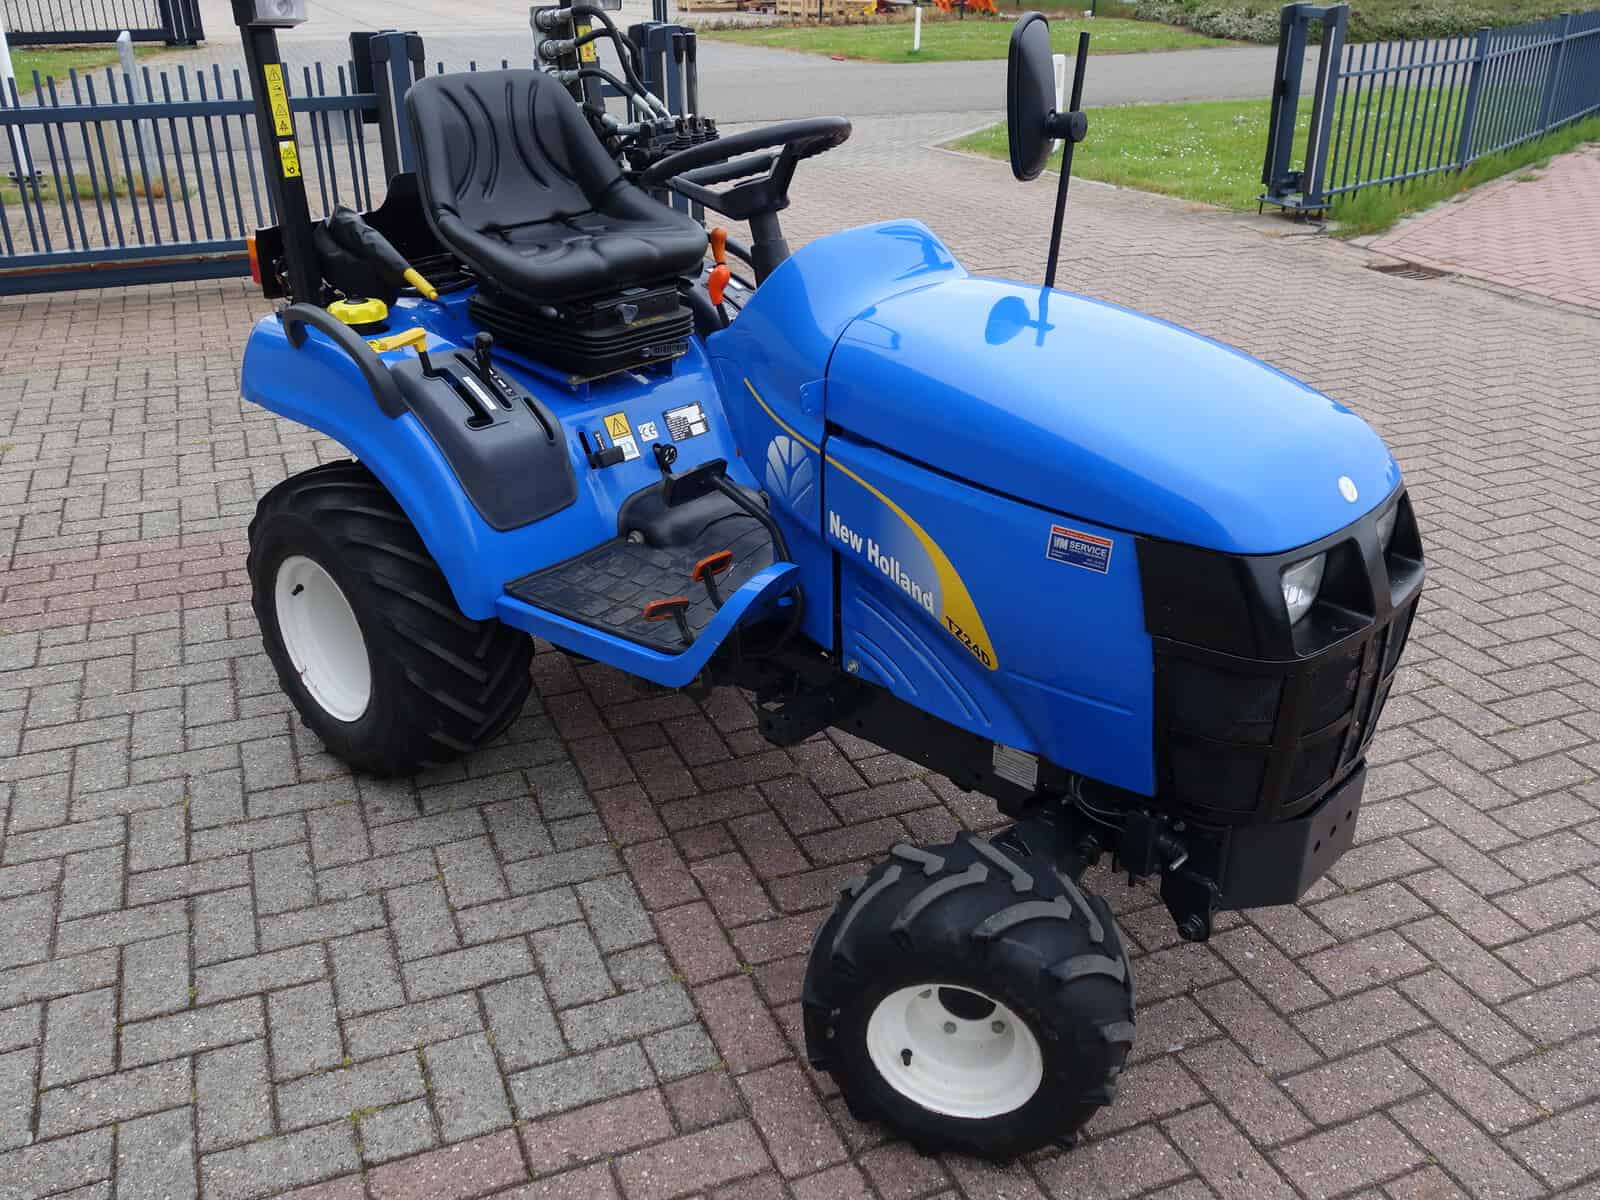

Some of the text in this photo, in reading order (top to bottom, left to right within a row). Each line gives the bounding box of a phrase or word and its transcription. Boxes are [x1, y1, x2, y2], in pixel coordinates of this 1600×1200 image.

[829, 510, 935, 614] New Holland
[1070, 540, 1107, 557] SERVICE
